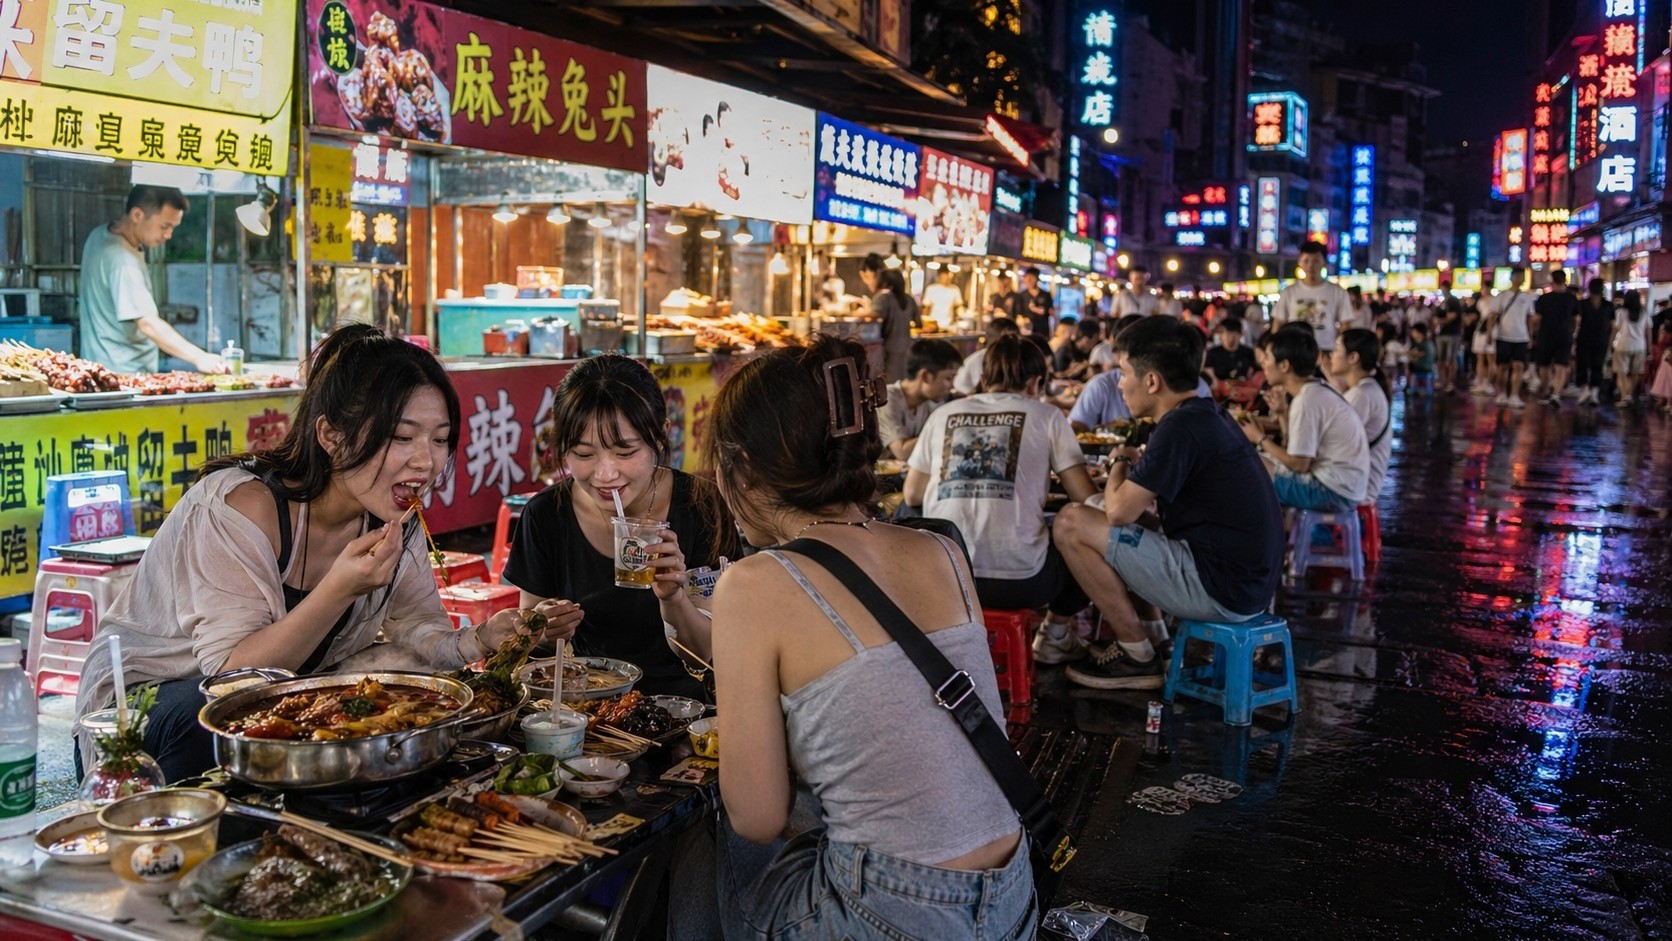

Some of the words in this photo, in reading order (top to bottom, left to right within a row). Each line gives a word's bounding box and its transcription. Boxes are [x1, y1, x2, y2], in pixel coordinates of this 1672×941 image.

[451, 32, 636, 148] 麻辣兔头
[947, 414, 1023, 429] CHALLENGE
